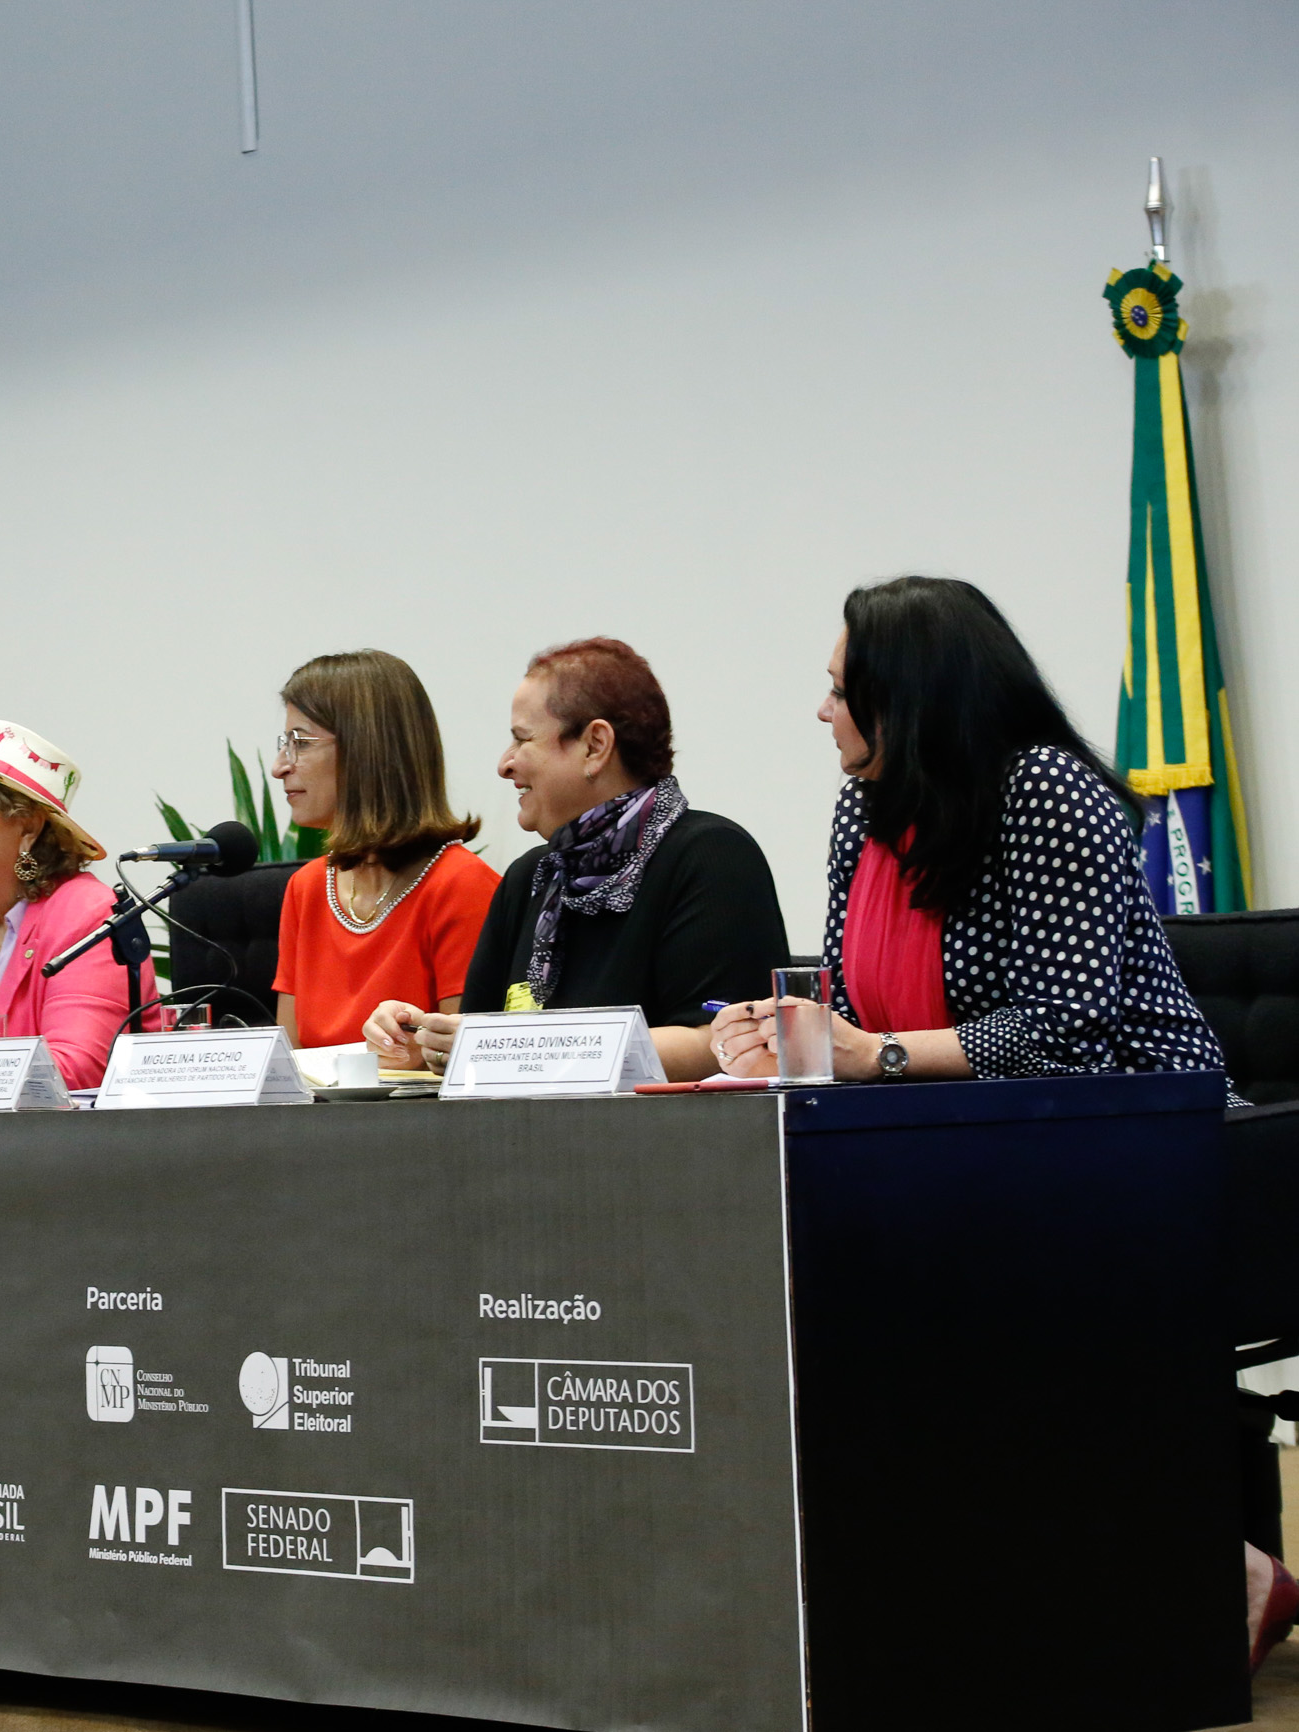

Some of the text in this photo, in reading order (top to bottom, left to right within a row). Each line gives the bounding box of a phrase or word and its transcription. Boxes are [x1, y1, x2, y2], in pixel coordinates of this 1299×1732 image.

[475, 1036, 602, 1050] ANASTASIA DIVINSKAYA
[142, 1052, 242, 1065] MIGUELINA VECCHIO
[469, 1052, 530, 1062] REPRESENTANTE
[544, 1052, 560, 1060] ONU
[561, 1051, 602, 1060] MULHERES
[518, 1064, 544, 1072] BRASIL
[86, 1286, 163, 1310] Parceria
[479, 1293, 601, 1324] Realização
[292, 1358, 350, 1378] Tribunal
[292, 1386, 354, 1408] Superior
[547, 1371, 680, 1405] CÂMARA DOS
[294, 1412, 352, 1432] Eleitoral
[548, 1406, 681, 1435] DEPUTADOS
[88, 1484, 192, 1546] MPF
[246, 1504, 330, 1532] SENADO
[88, 1547, 192, 1566] Ministério Público Federal
[248, 1534, 333, 1562] FEDERAL
